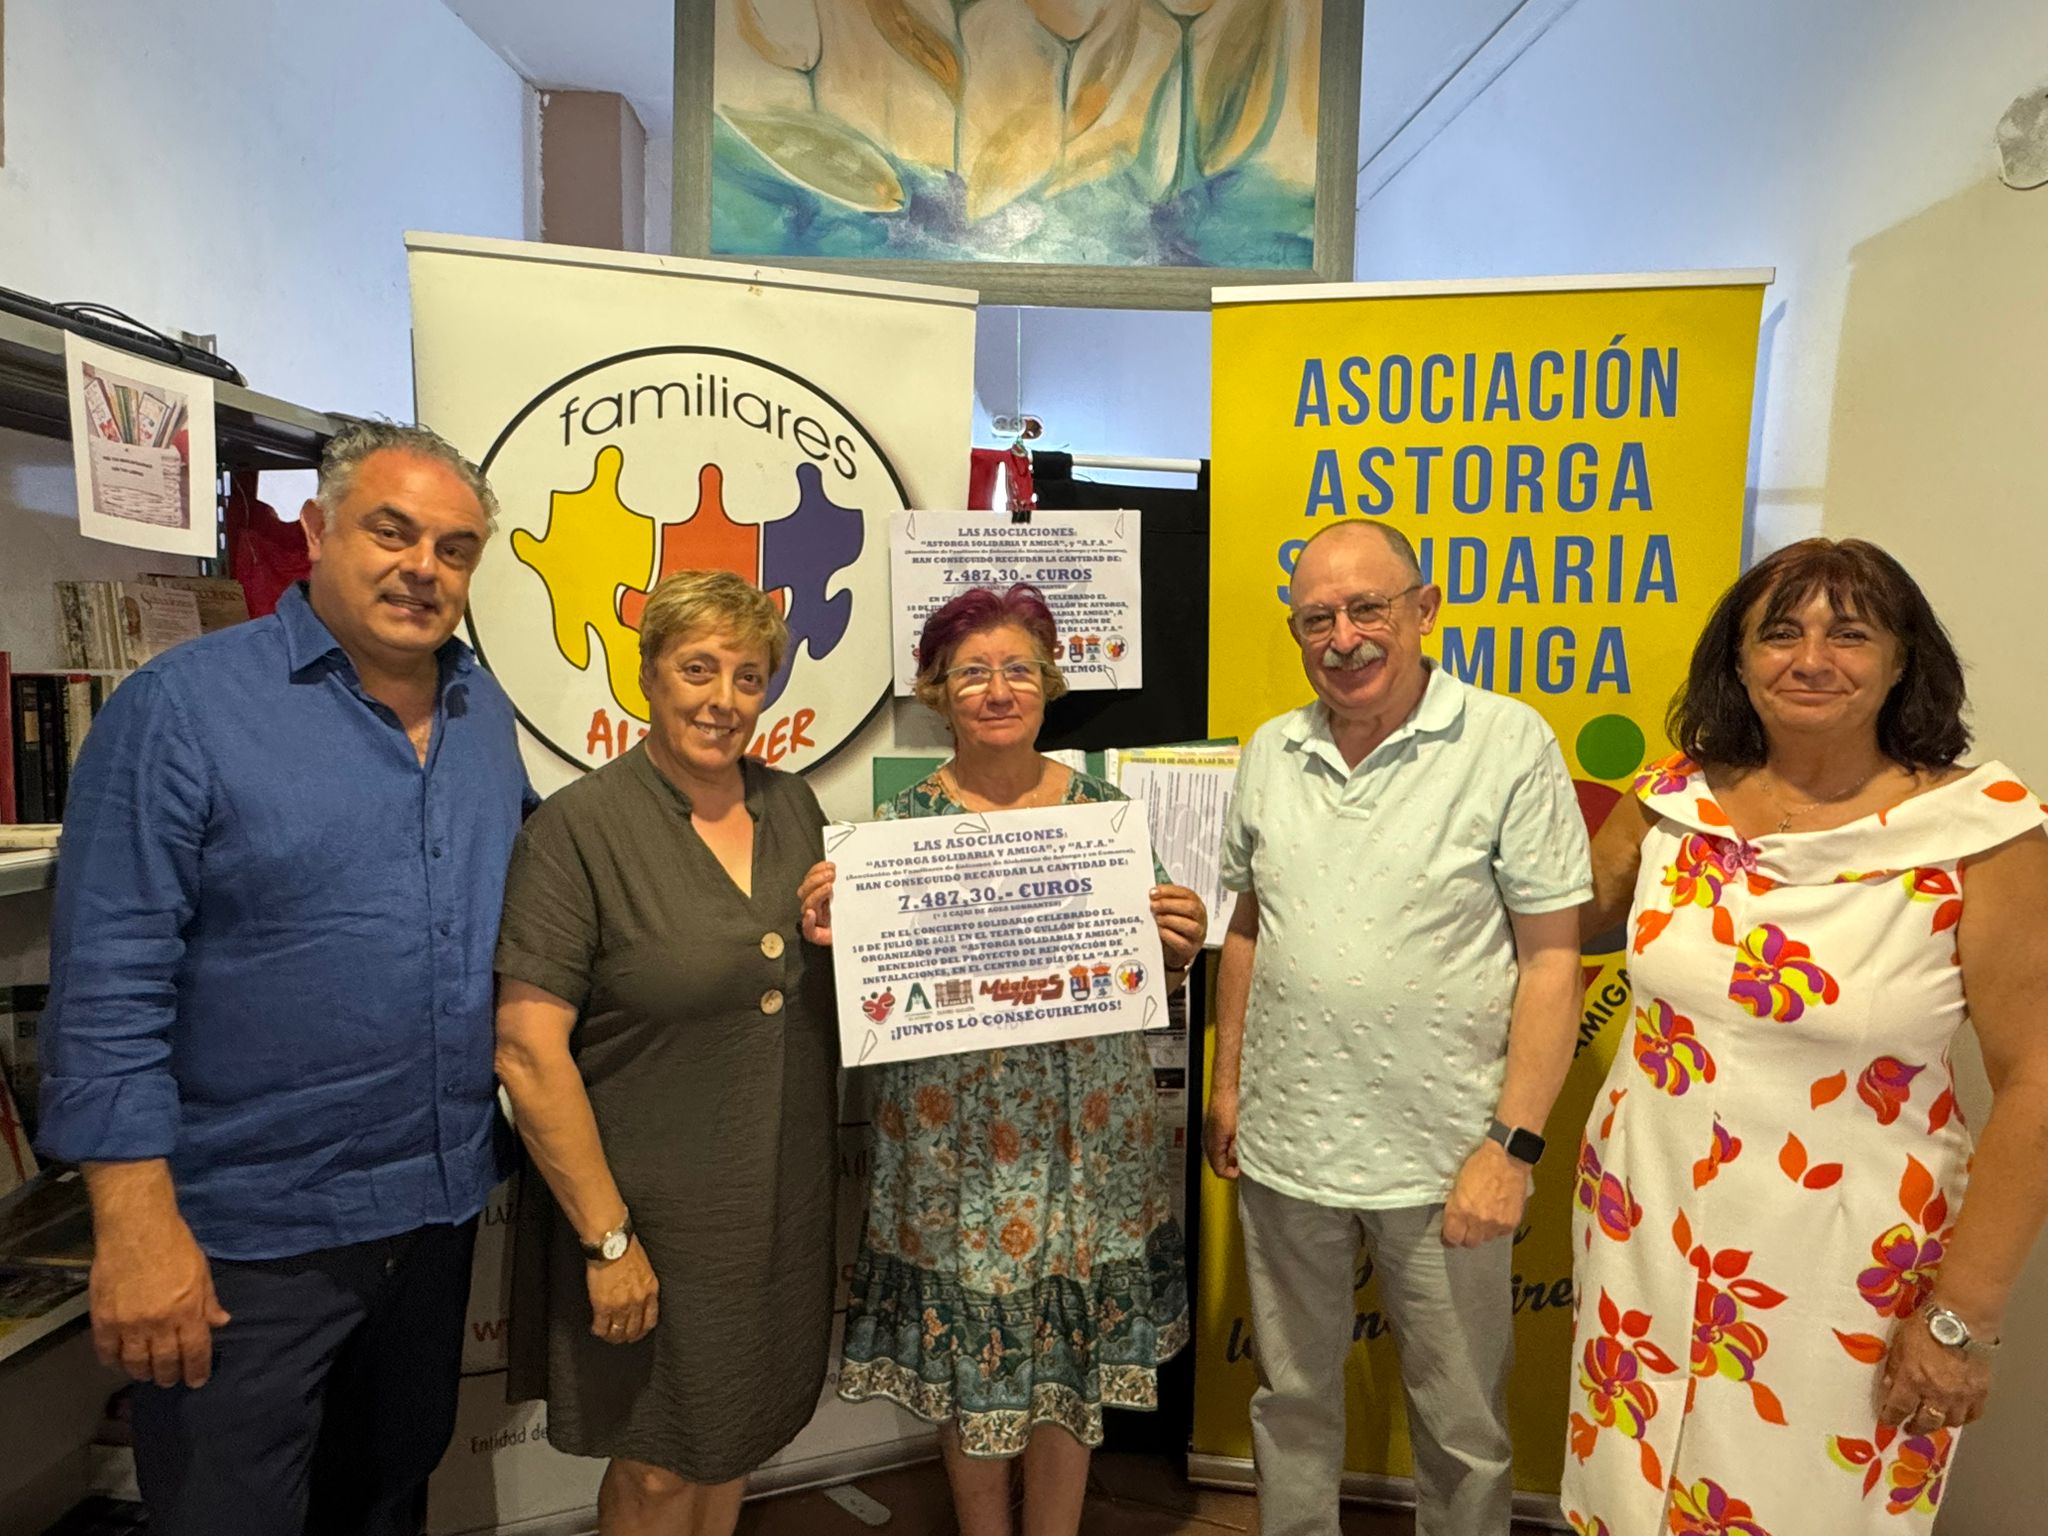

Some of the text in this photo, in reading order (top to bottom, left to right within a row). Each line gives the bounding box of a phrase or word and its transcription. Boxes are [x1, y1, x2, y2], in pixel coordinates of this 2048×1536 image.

[1294, 334, 1679, 427] ASOCIACIÓN
[559, 372, 856, 479] familiares
[1305, 441, 1653, 517] ASTORGA
[958, 528, 1077, 537] LAS ASOCIACIONES:
[1277, 534, 1678, 605] SIDARIA
[1442, 626, 1631, 695] MIGA
[865, 838, 1115, 869] “ASTORGA SOLIDARIA Y AMIGA”, y “A.F.A.”
[913, 828, 1068, 851] LAS ASOCIACIONES:
[855, 857, 1128, 890] HAN CONSEGUIDO RECAUDAR LA CANTIDAD DE:
[898, 885, 1013, 911] 7.487,30.-
[866, 942, 881, 951] DE
[883, 939, 912, 950] JULIO
[914, 937, 929, 946] DE
[958, 933, 972, 941] EN
[974, 931, 987, 940] EL
[989, 927, 1031, 938] TEATRO
[1033, 921, 1075, 933] GULLÓN
[1077, 921, 1091, 929] DE
[1093, 915, 1143, 928] ASTORGA,
[880, 930, 895, 938] EN
[897, 928, 911, 936] EL
[913, 922, 974, 935] CONCIERTO
[977, 916, 1034, 928] SOLIDARIO
[1036, 909, 1099, 922] CELEBRADO
[861, 948, 931, 962] ORGANIZADO
[934, 946, 957, 954] POR
[960, 939, 1016, 952] “ASTORGA
[1017, 933, 1073, 945] SOLIDARIA
[877, 938, 1122, 971] BENEDICIO DEL PROYECTO DE RENOVACIÓN DE
[862, 968, 950, 984] INSTALACIONES,
[952, 966, 966, 974] EN
[968, 964, 981, 972] EL
[983, 959, 1026, 971] CENTRO
[1028, 957, 1043, 966] DE
[1045, 955, 1063, 964] DÍA
[1065, 953, 1080, 961] DE
[1082, 952, 1094, 960] LA
[890, 1019, 955, 1040] ¡JUNTOS
[957, 1016, 977, 1030] LO
[981, 999, 1121, 1027] CONSEGUIREMOS!
